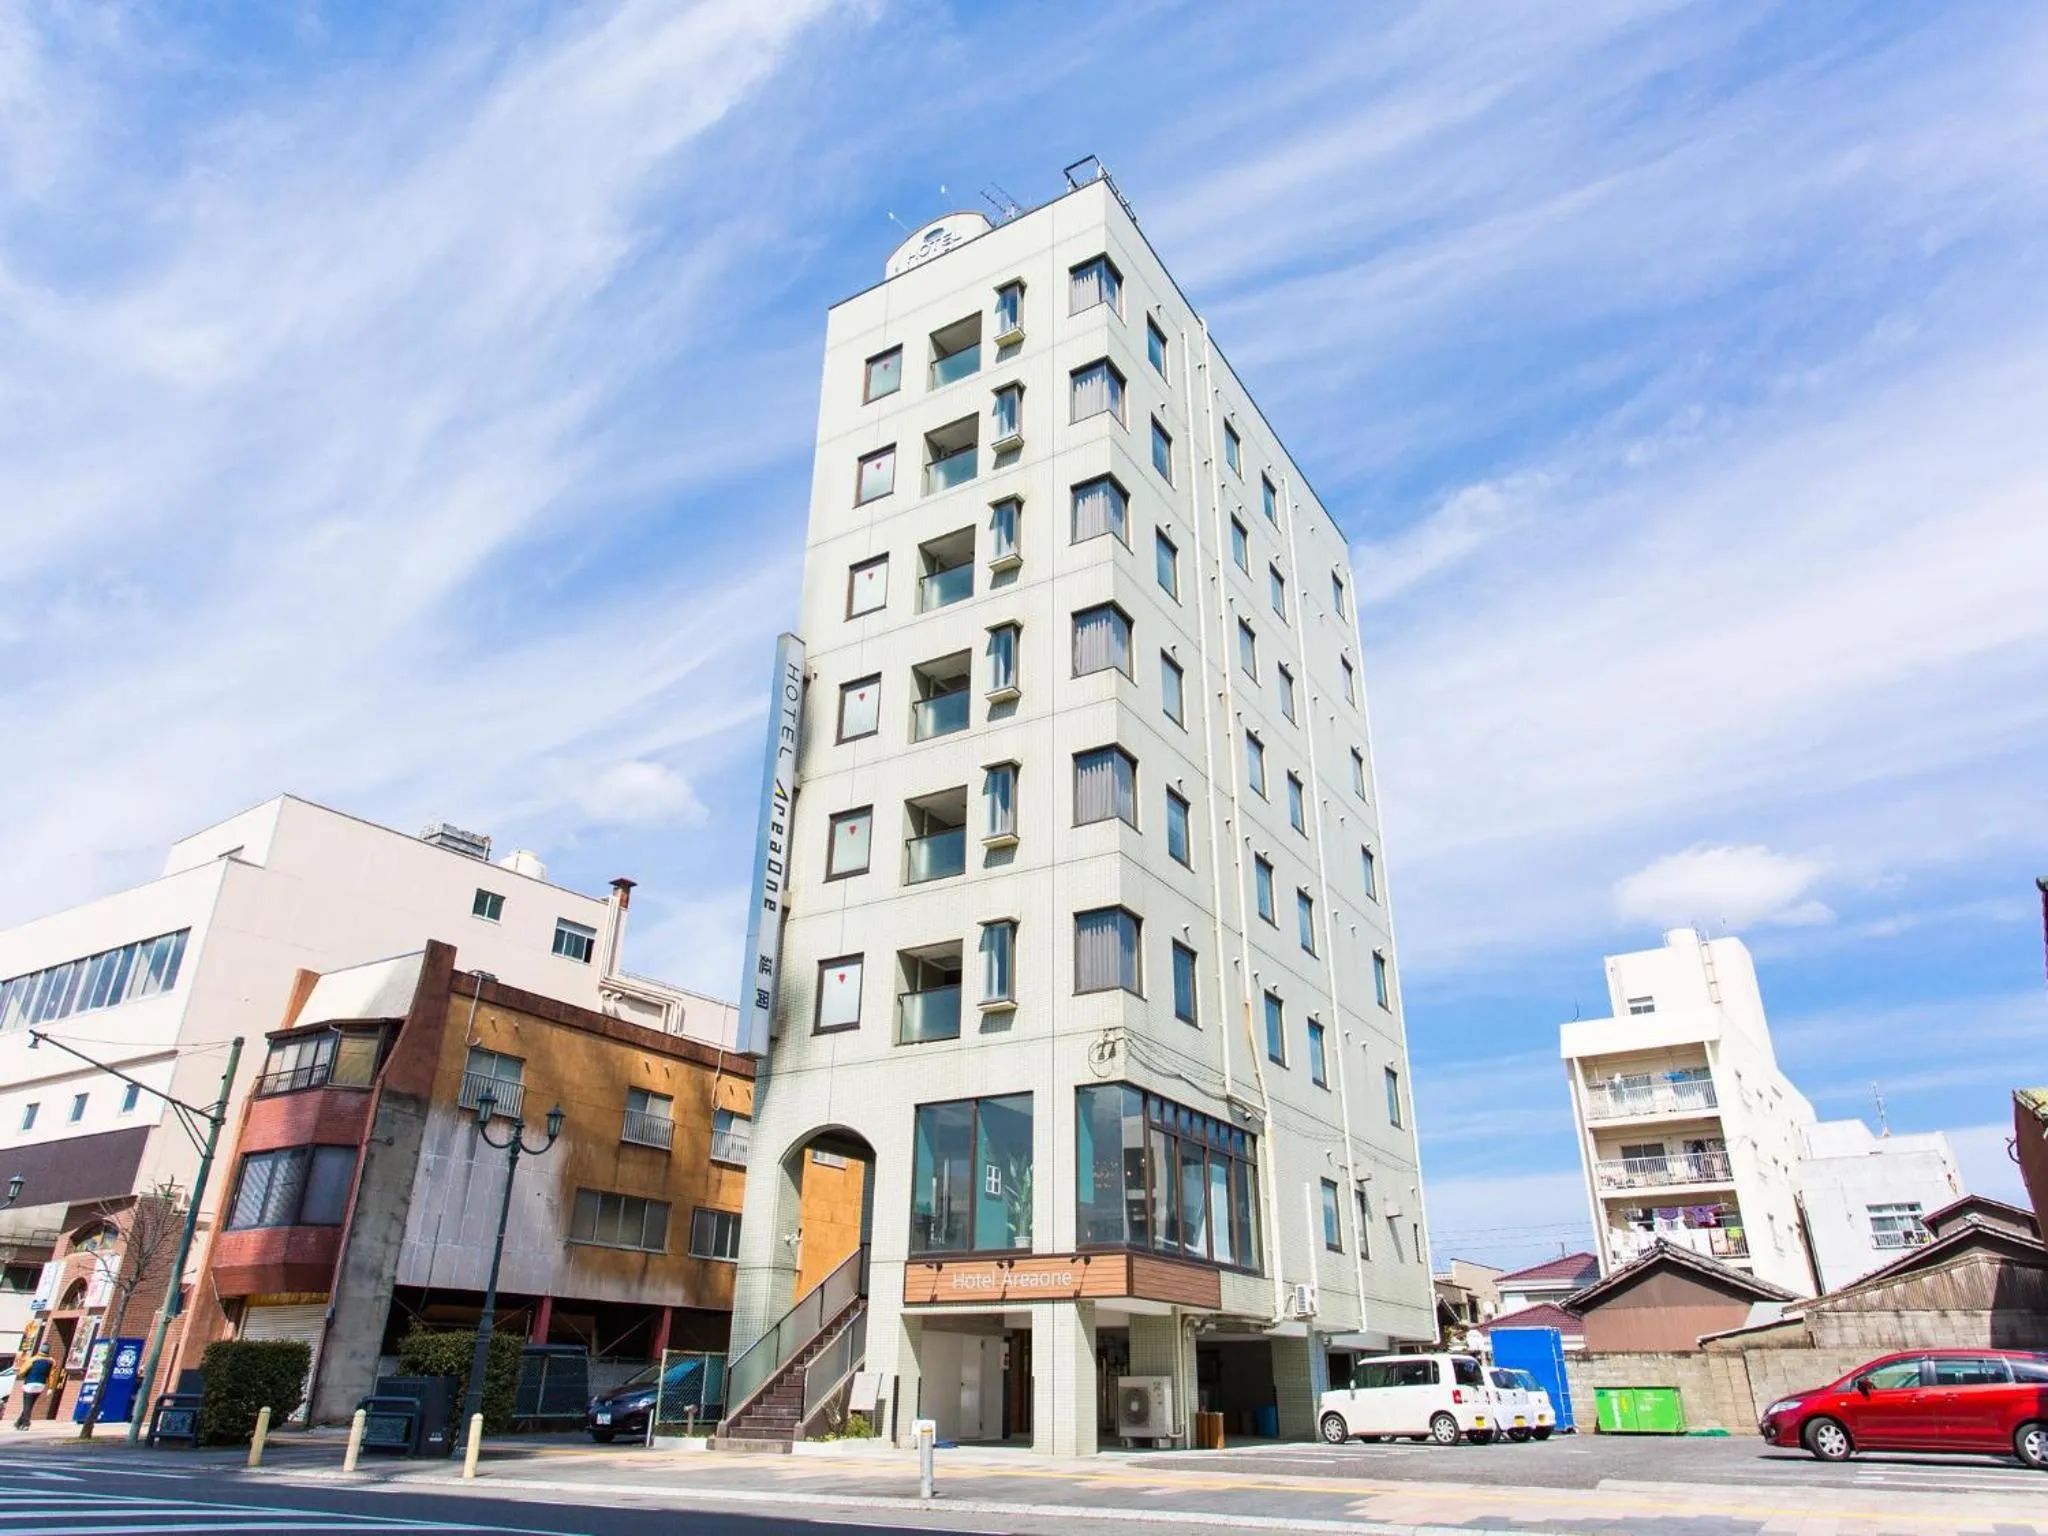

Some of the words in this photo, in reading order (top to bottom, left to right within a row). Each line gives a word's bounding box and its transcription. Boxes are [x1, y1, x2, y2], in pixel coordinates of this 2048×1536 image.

[779, 662, 800, 758] HOTEL
[953, 1271, 996, 1289] Hotel
[113, 1367, 134, 1376] BOSS
